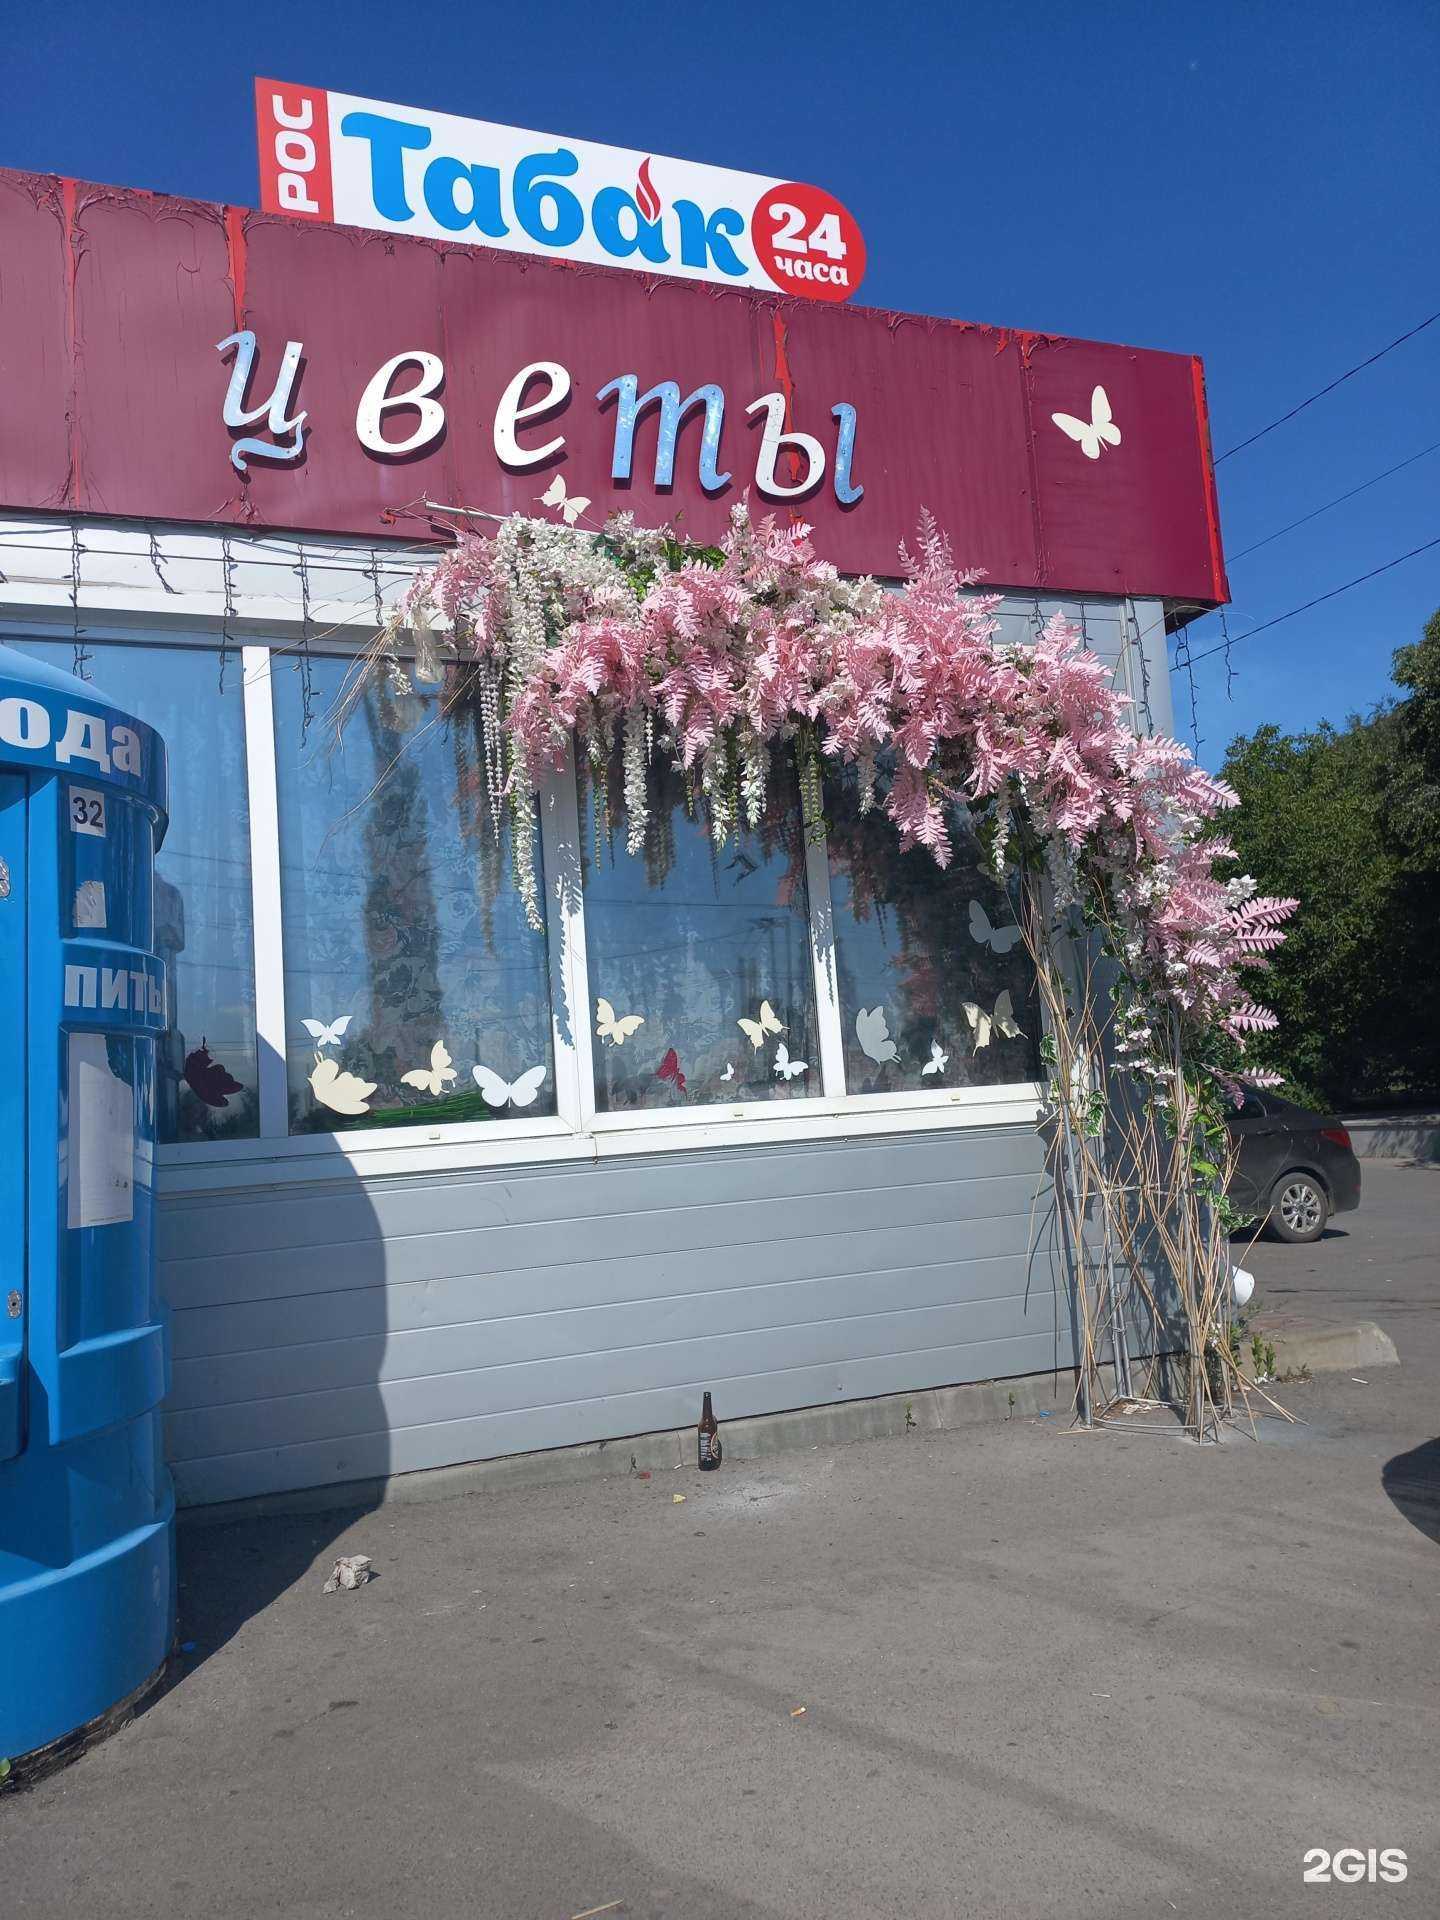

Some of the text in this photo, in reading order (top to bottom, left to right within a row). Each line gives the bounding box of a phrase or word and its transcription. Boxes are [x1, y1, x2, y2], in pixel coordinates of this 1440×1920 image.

[272, 94, 319, 213] РОС
[341, 111, 749, 276] Табак
[768, 203, 847, 260] 24
[774, 255, 850, 286] часа
[72, 797, 104, 828] 32
